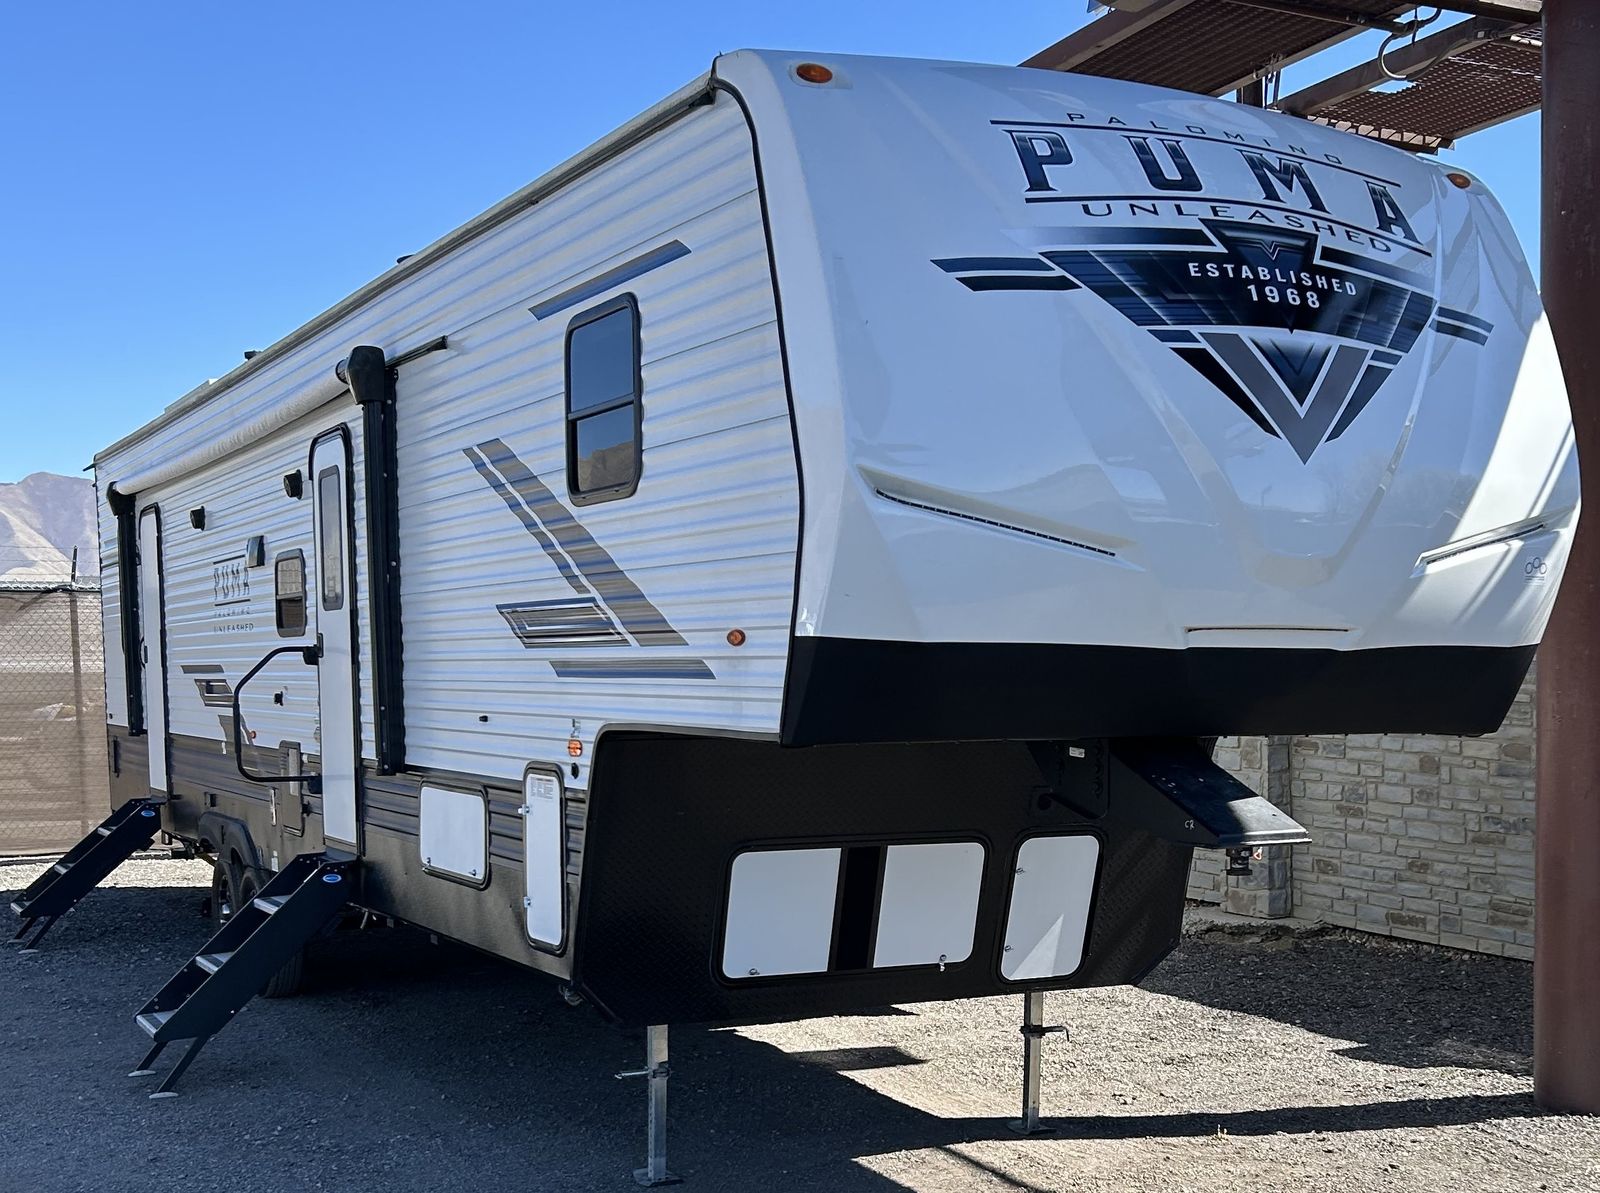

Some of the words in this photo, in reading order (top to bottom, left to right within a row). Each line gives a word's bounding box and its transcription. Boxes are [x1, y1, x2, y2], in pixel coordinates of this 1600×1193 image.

[1067, 112, 1341, 164] PALOMINO
[1003, 129, 1424, 245] PUMA
[1082, 203, 1392, 253] UNLEASHED
[1188, 262, 1357, 296] ESTABLISHED
[1247, 284, 1320, 309] 1968
[213, 563, 250, 600] PUMA
[213, 622, 254, 632] UNLEASHED
